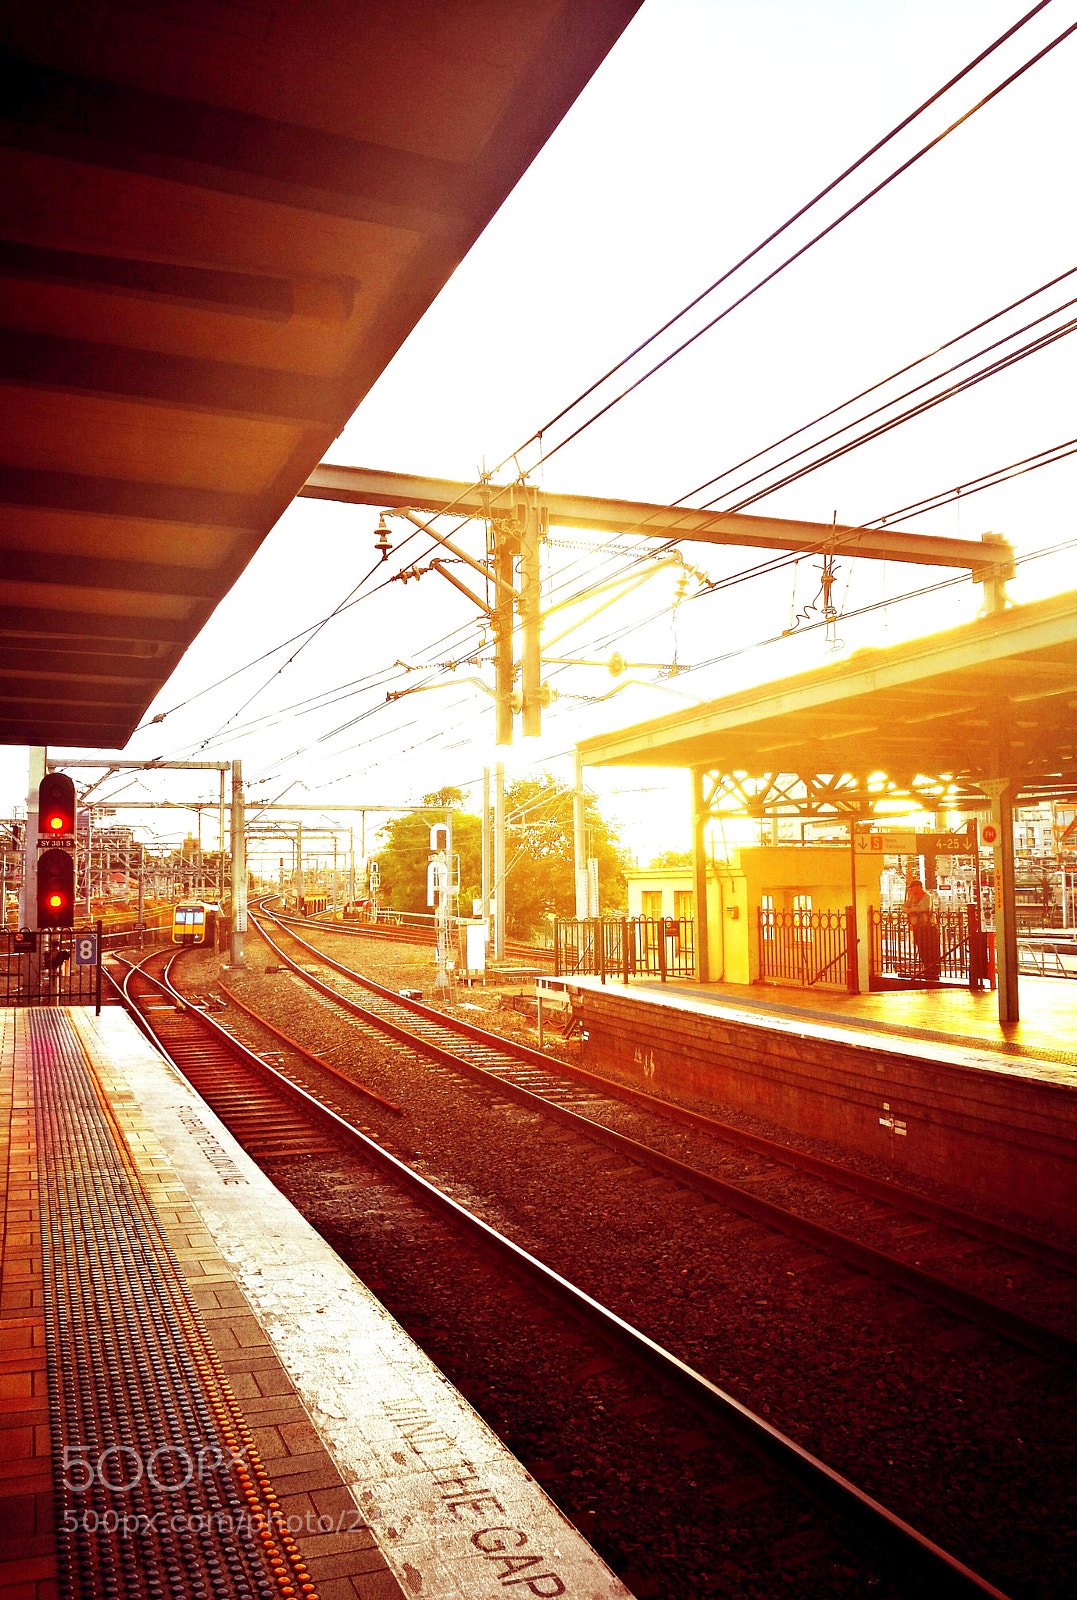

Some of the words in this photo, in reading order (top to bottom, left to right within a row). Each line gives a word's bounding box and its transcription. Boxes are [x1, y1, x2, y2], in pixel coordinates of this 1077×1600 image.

[936, 838, 960, 849] 4-25
[79, 939, 93, 960] 8
[469, 1524, 567, 1599] GAP
